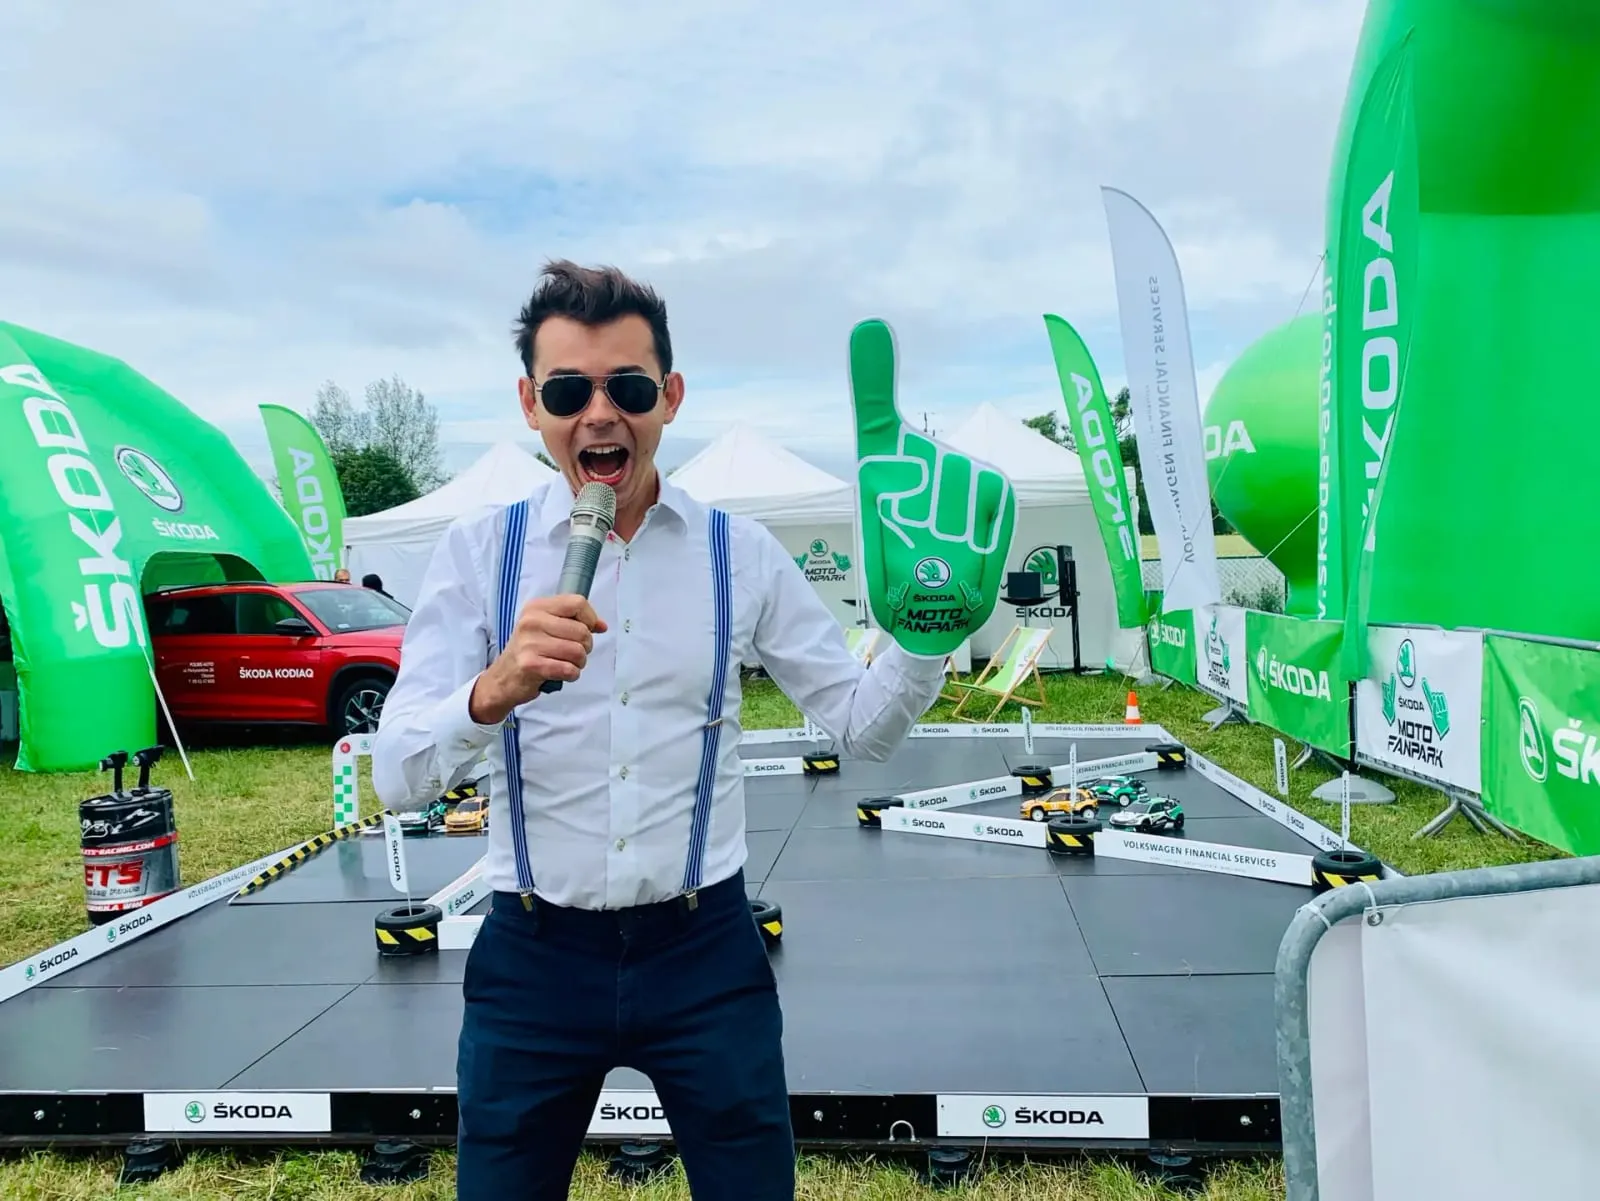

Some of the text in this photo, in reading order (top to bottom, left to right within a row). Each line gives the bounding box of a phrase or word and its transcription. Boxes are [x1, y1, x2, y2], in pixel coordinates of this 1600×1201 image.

[152, 517, 219, 540] ŠKODA
[913, 594, 956, 602] ŠKODA
[907, 608, 963, 620] MOTO
[898, 618, 969, 633] FANPARK
[240, 667, 314, 679] ŠKODA KODIAQ
[1269, 654, 1331, 701] ŠKODA
[1398, 696, 1424, 711] ŠKODA
[1398, 719, 1432, 743] MOTO
[1388, 735, 1443, 768] FANPARK
[980, 785, 1006, 796] ŠKODA
[919, 796, 948, 808] ŠKODA
[912, 819, 945, 829] ŠKODA
[987, 826, 1024, 837] ŠKODA
[392, 840, 402, 881] ŠKODA
[1123, 839, 1182, 855] VOLKSWAGEN
[1185, 848, 1232, 862] FINANCIAL
[1234, 854, 1277, 868] SERVICES
[119, 912, 153, 936] ŠKODA
[39, 947, 79, 973] ŠKODA
[213, 1102, 292, 1119] ŠKODA
[1014, 1106, 1104, 1125] ŠKODA
